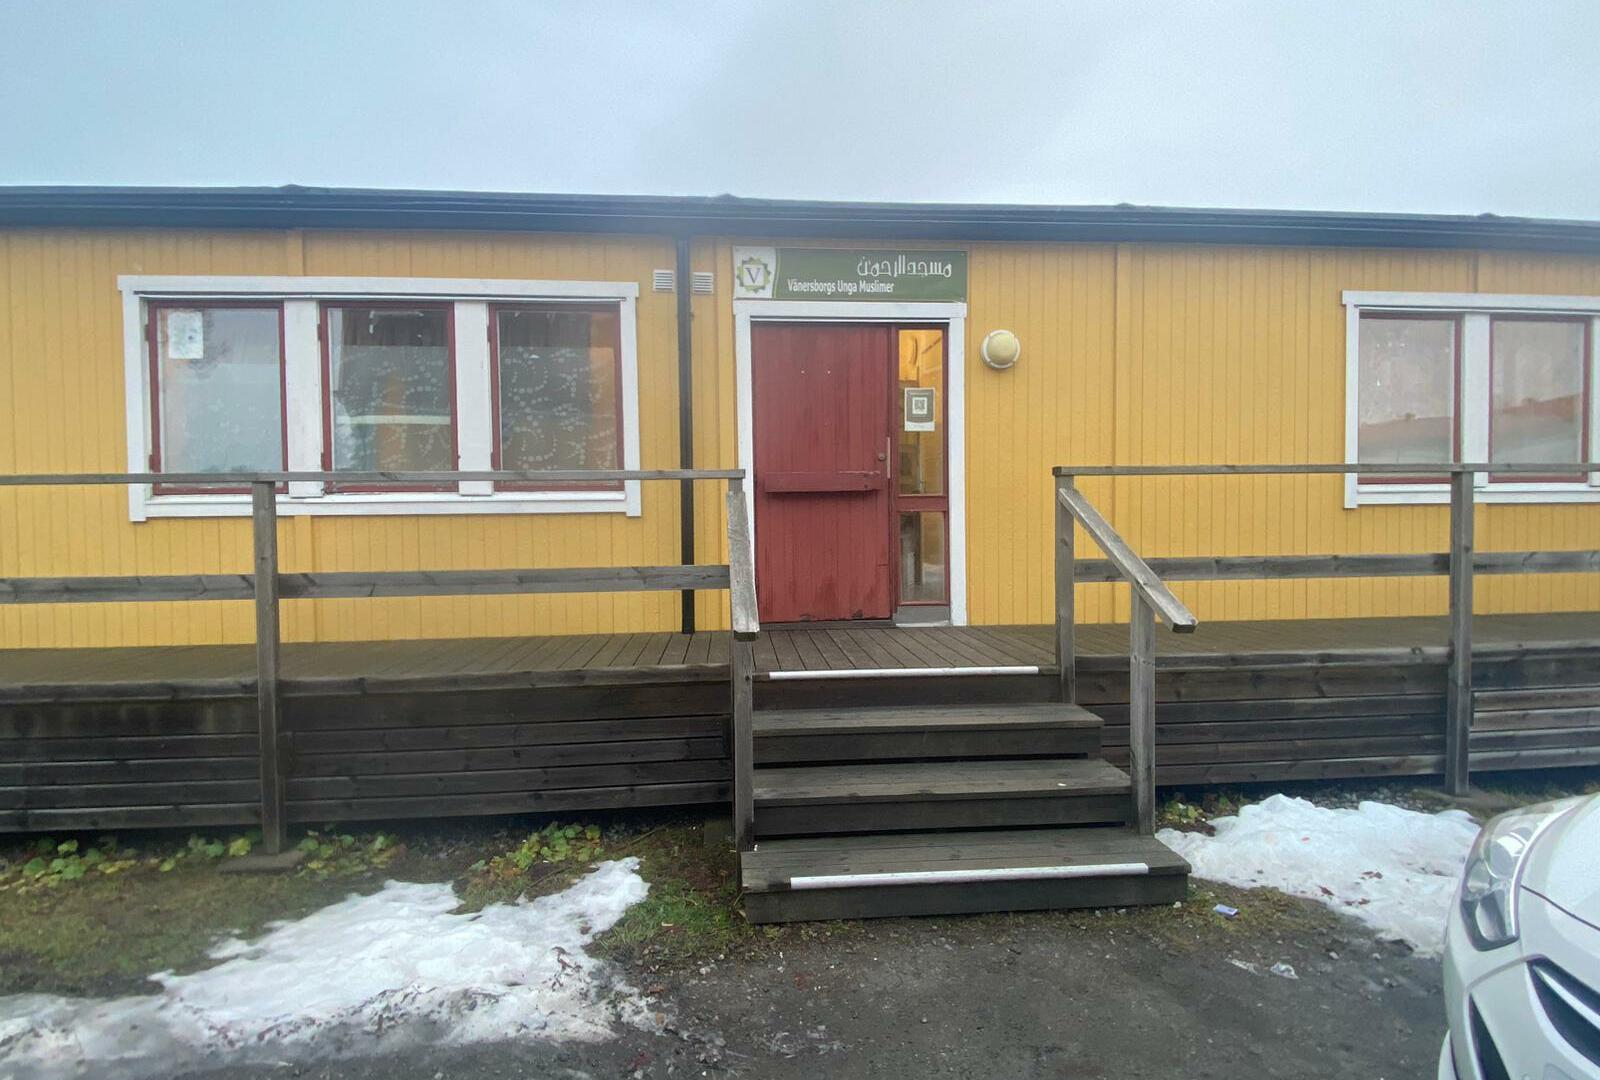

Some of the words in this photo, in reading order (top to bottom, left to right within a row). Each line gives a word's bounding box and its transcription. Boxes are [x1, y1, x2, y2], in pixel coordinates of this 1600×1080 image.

[744, 267, 761, 284] V
[907, 260, 952, 278] مسجد
[787, 279, 835, 295] Vänersborgs
[837, 280, 857, 295] Unga
[859, 280, 895, 293] Muslimer
